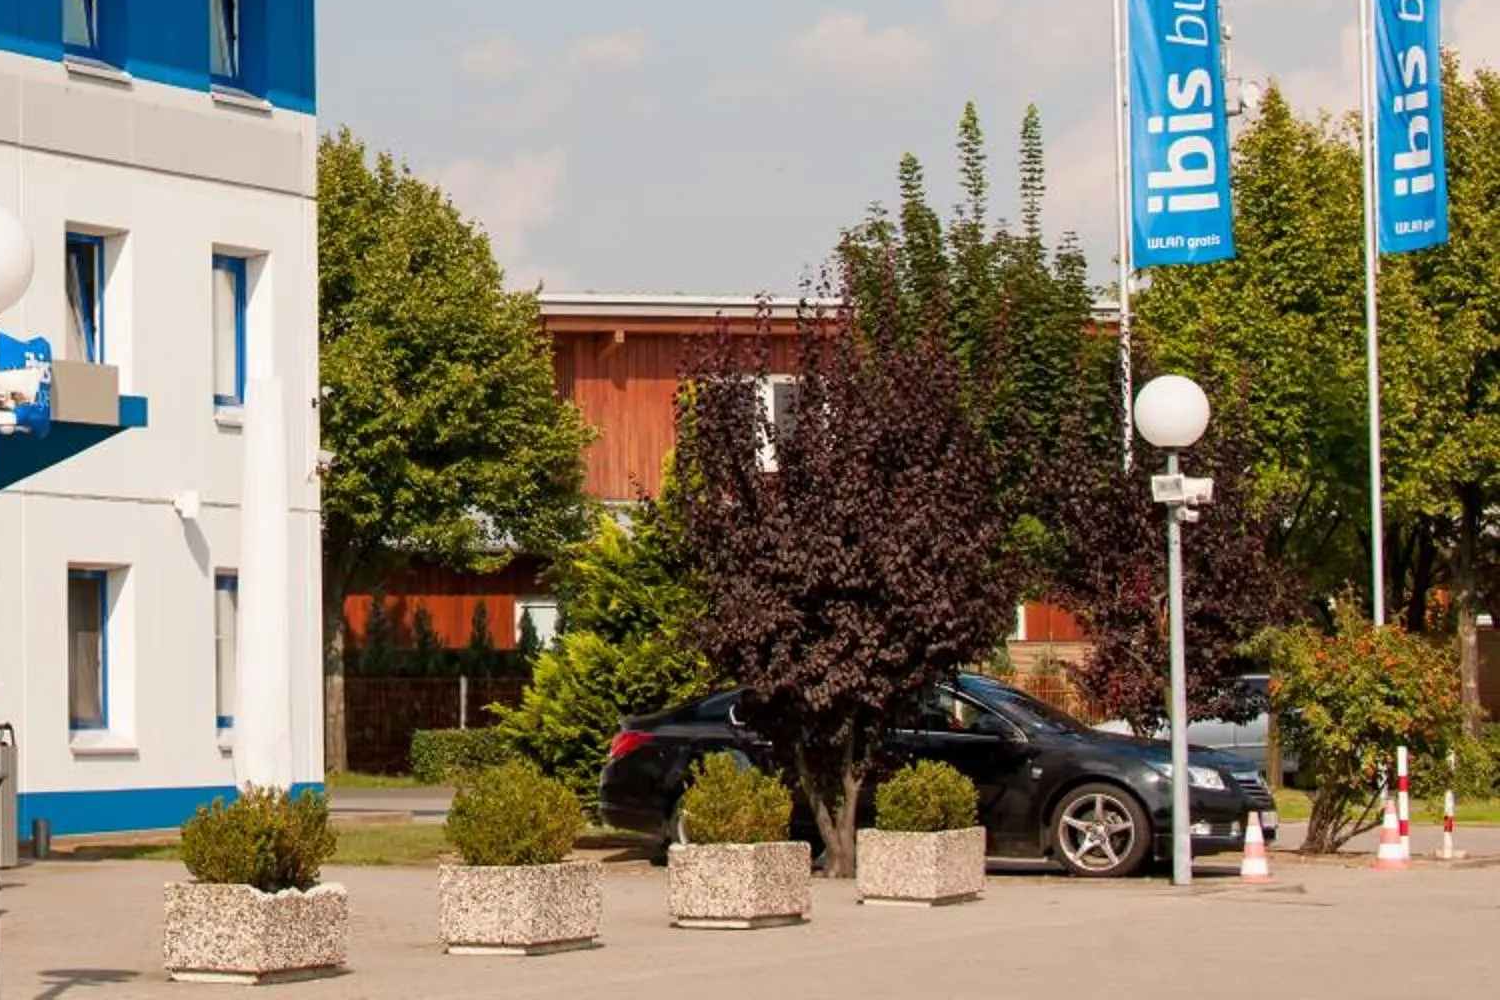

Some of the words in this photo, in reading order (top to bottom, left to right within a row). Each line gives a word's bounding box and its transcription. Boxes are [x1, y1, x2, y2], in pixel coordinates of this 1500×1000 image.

[1147, 67, 1221, 213] ibis
[1393, 44, 1435, 196] ibis
[1147, 235, 1185, 249] WLAN
[1187, 233, 1221, 250] gratis
